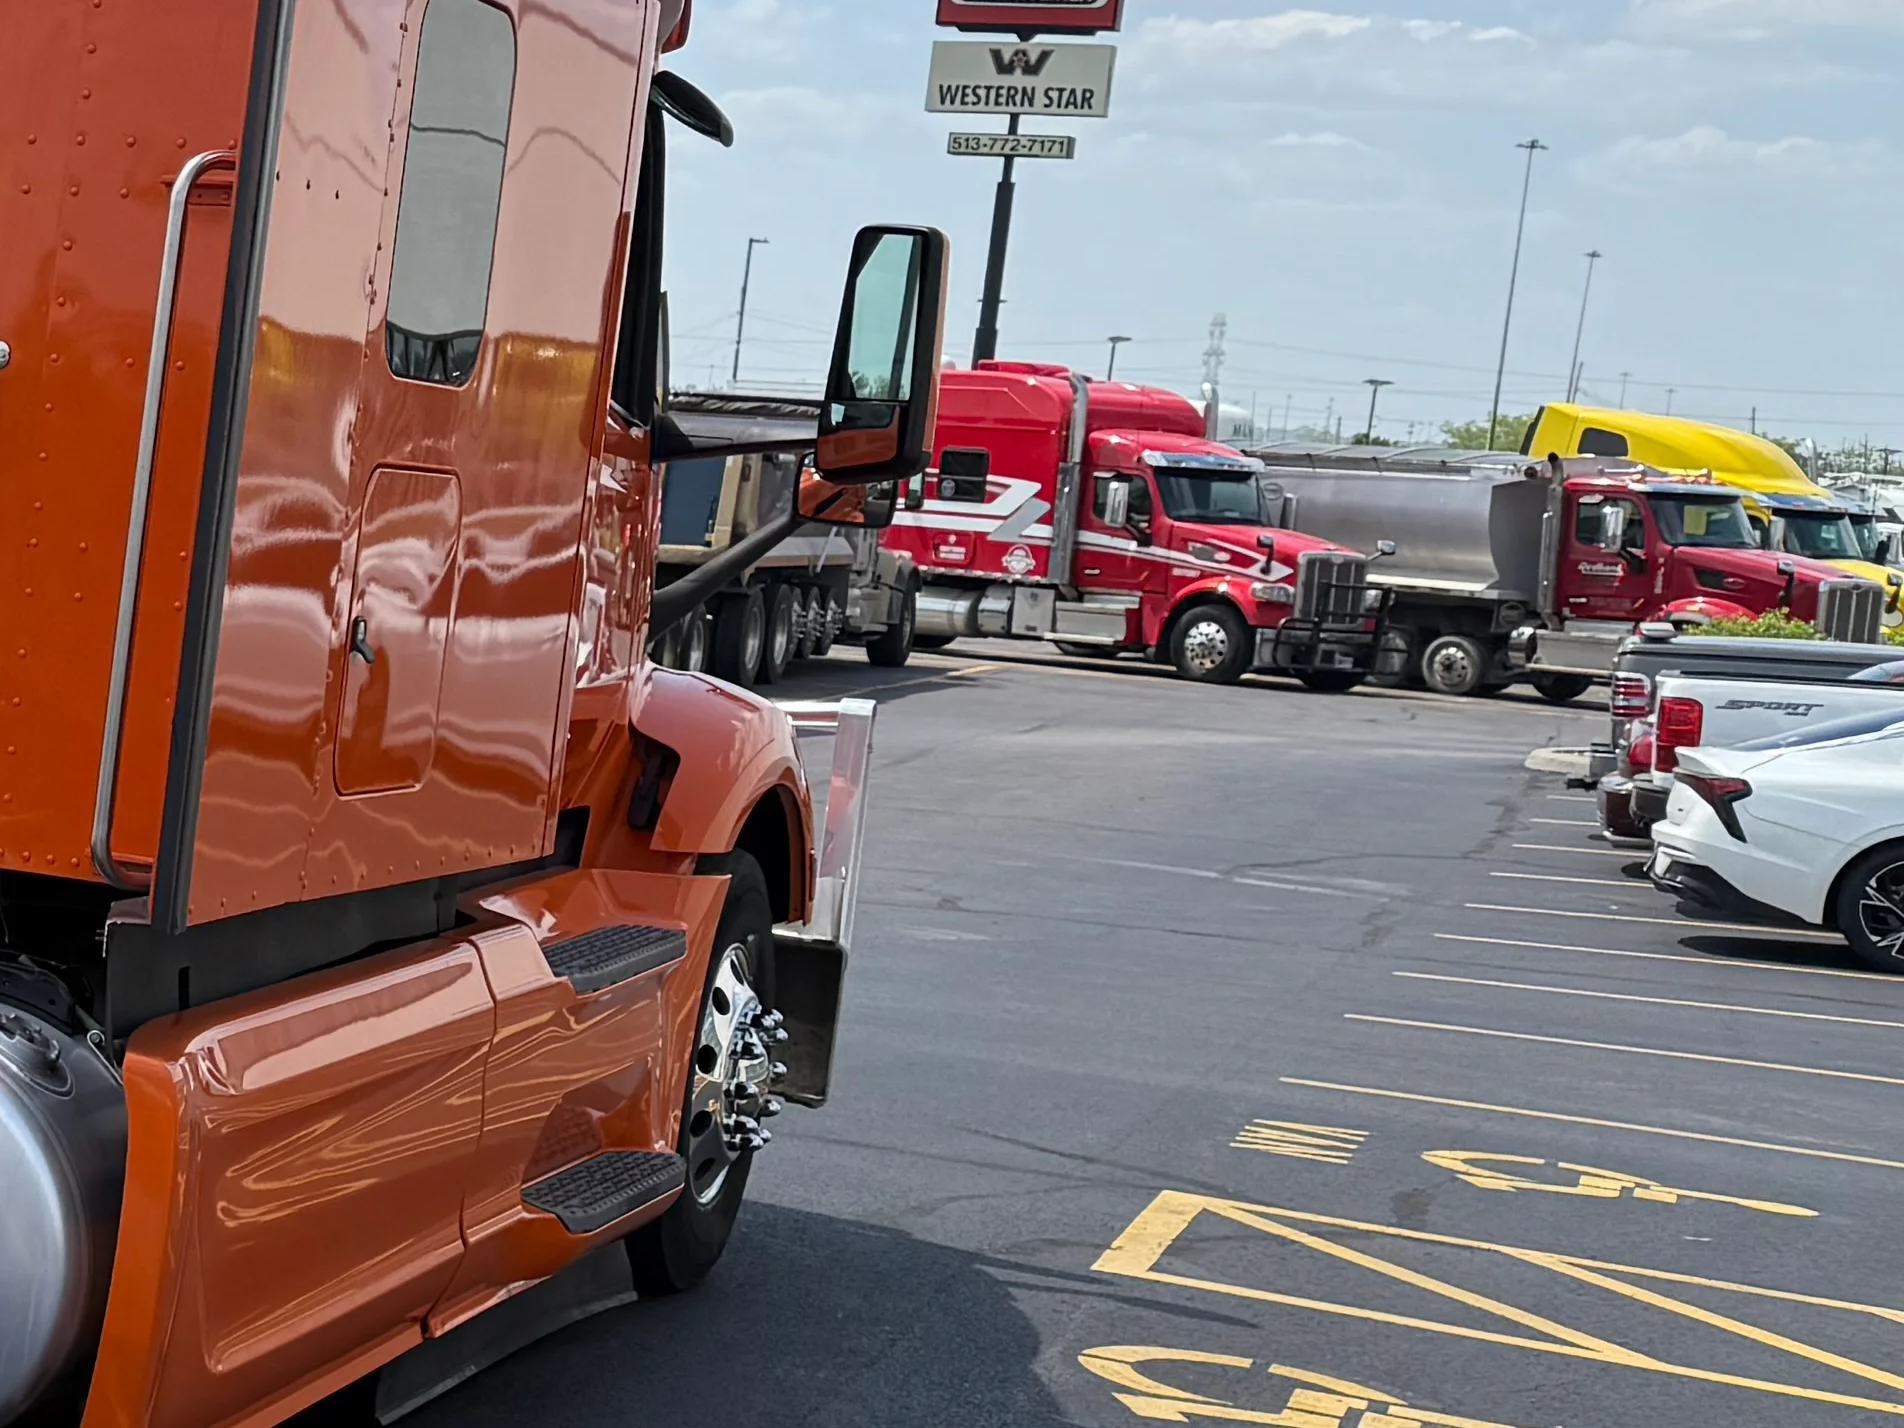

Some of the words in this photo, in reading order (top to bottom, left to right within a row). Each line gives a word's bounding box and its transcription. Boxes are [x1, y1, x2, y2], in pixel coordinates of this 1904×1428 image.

[939, 84, 1036, 108] WESTERN
[1043, 86, 1095, 110] STAR
[952, 137, 1065, 154] 513-772-7171
